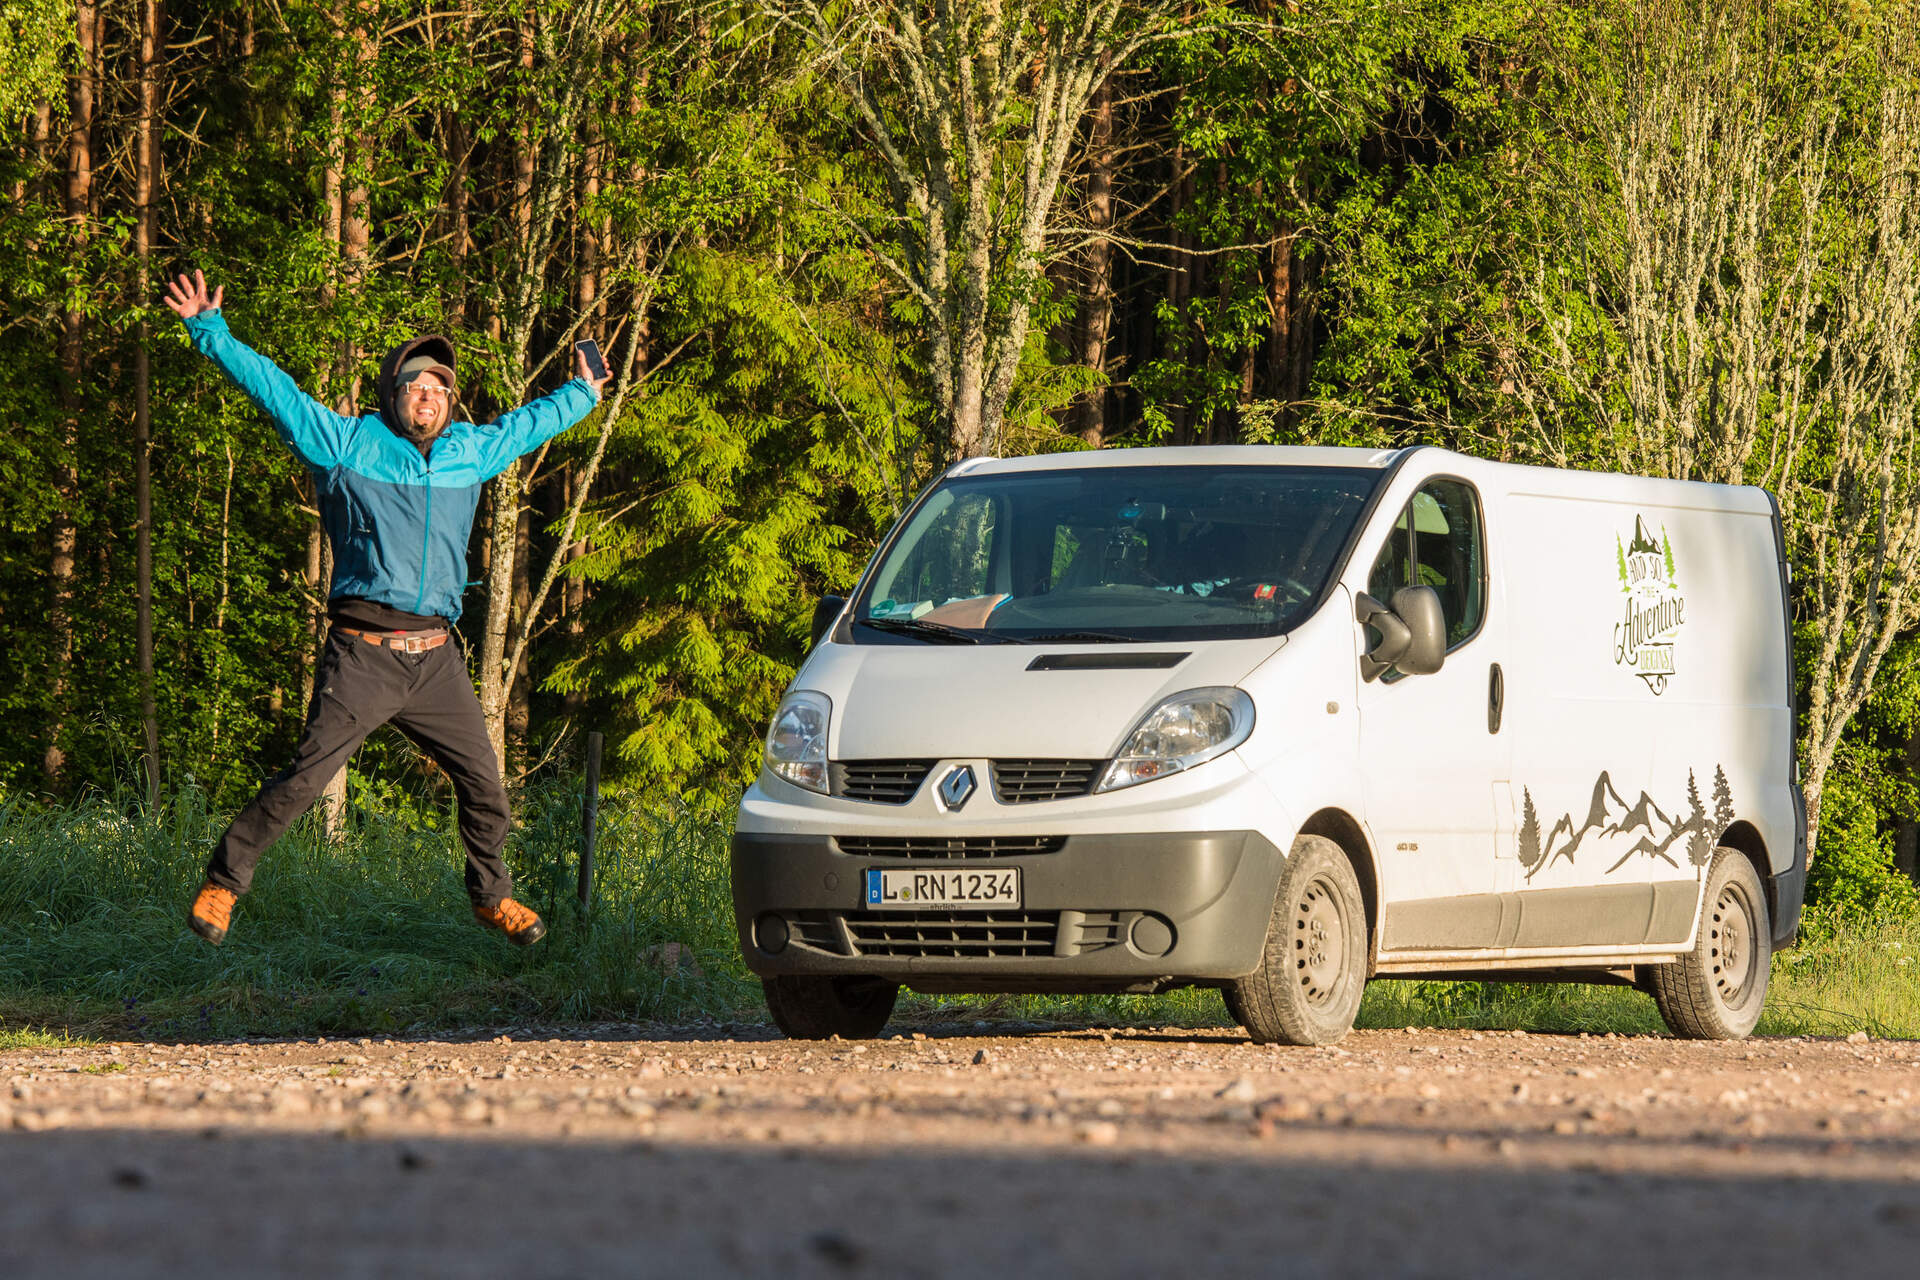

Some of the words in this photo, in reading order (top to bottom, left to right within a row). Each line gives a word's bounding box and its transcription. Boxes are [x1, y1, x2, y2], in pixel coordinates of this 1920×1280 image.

[1629, 556, 1646, 584] AND
[1641, 586, 1656, 598] THE
[1614, 595, 1686, 665] Adventure
[1640, 648, 1670, 670] BEGINS
[883, 875, 898, 900] L
[914, 874, 946, 900] RN
[952, 874, 1014, 900] 1234
